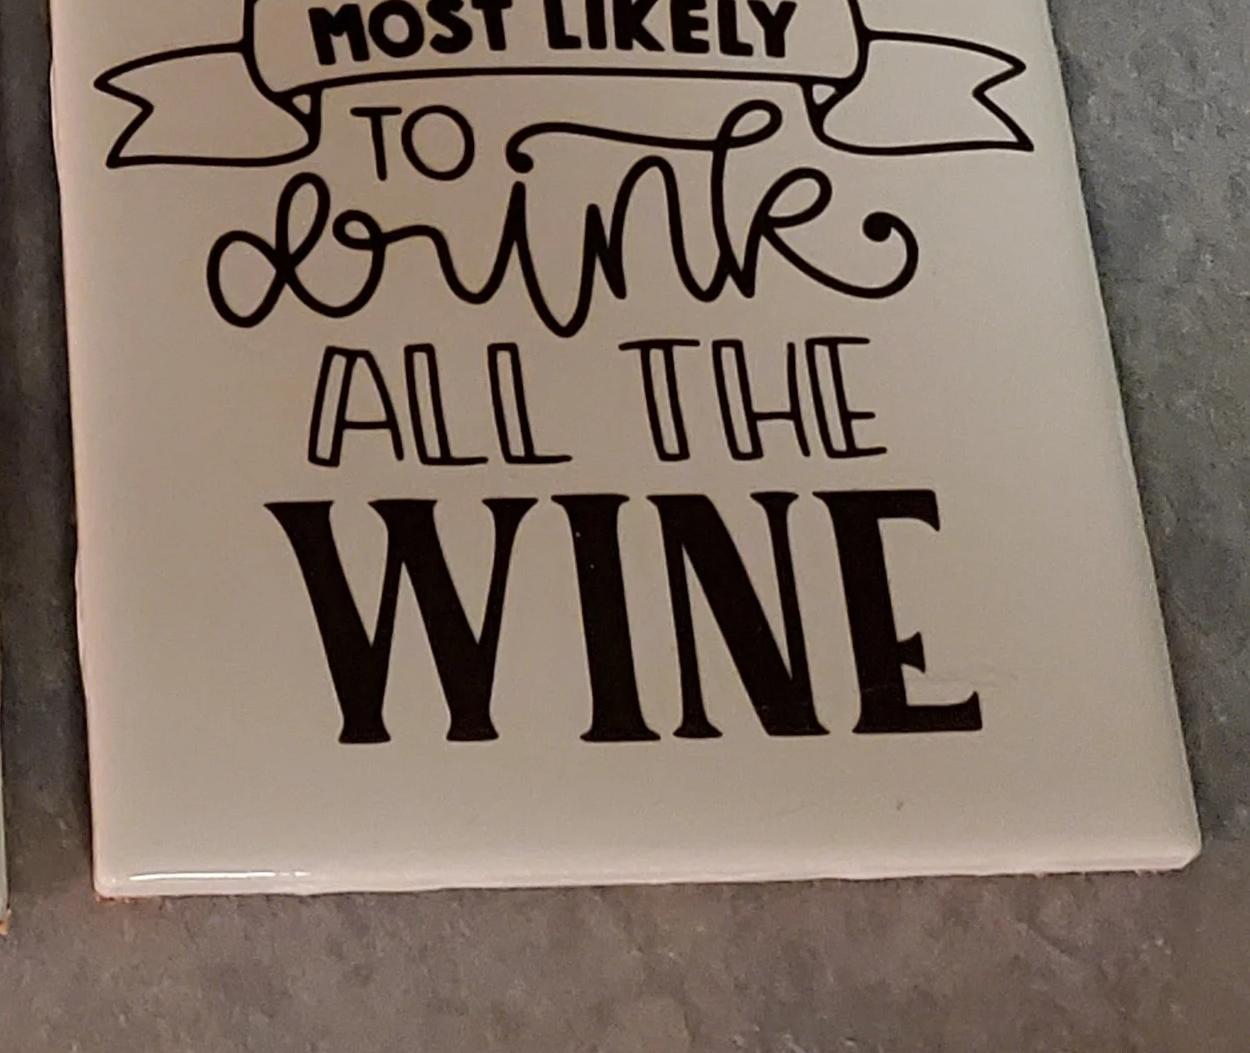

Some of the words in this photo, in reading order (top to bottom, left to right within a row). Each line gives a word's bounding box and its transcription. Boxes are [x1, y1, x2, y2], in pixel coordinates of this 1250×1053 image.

[206, 99, 920, 339] drink
[349, 104, 477, 182] TO
[307, 341, 574, 469] ALL
[617, 336, 889, 463] THE
[263, 488, 984, 745] WINE
